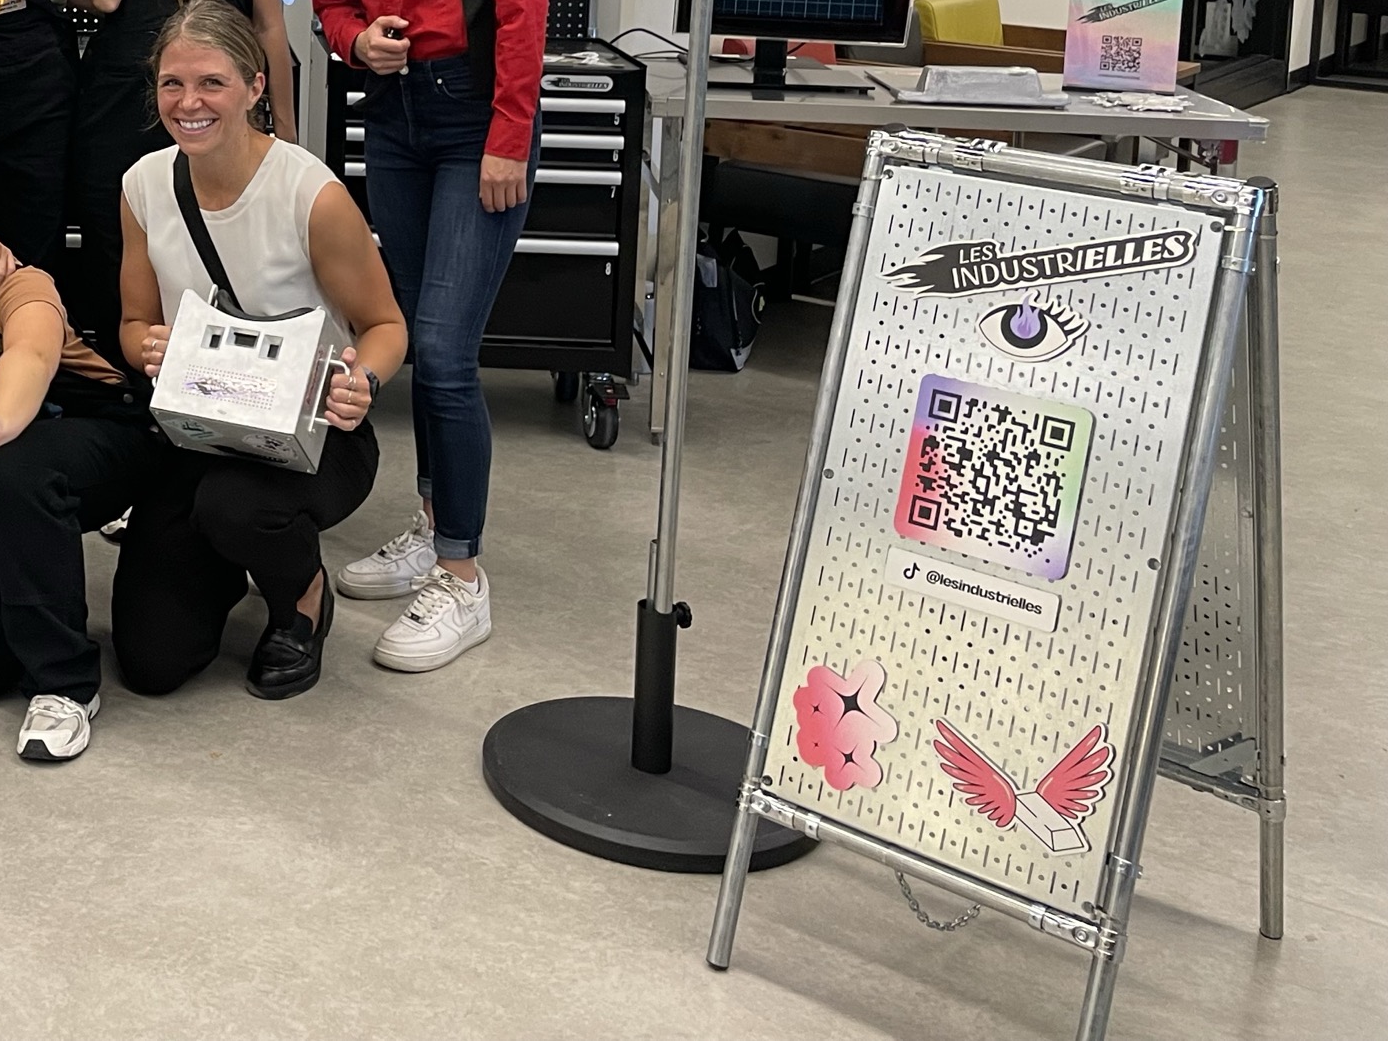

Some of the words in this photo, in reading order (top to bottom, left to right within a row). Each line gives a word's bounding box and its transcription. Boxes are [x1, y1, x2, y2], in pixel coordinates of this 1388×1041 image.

[614, 113, 620, 125] 5
[613, 150, 619, 162] 6
[611, 186, 617, 198] 7
[959, 244, 995, 264] LES
[951, 233, 1188, 289] INDUSTRIELLES
[605, 262, 612, 275] 8
[926, 570, 1043, 615] @lesindustrielles
